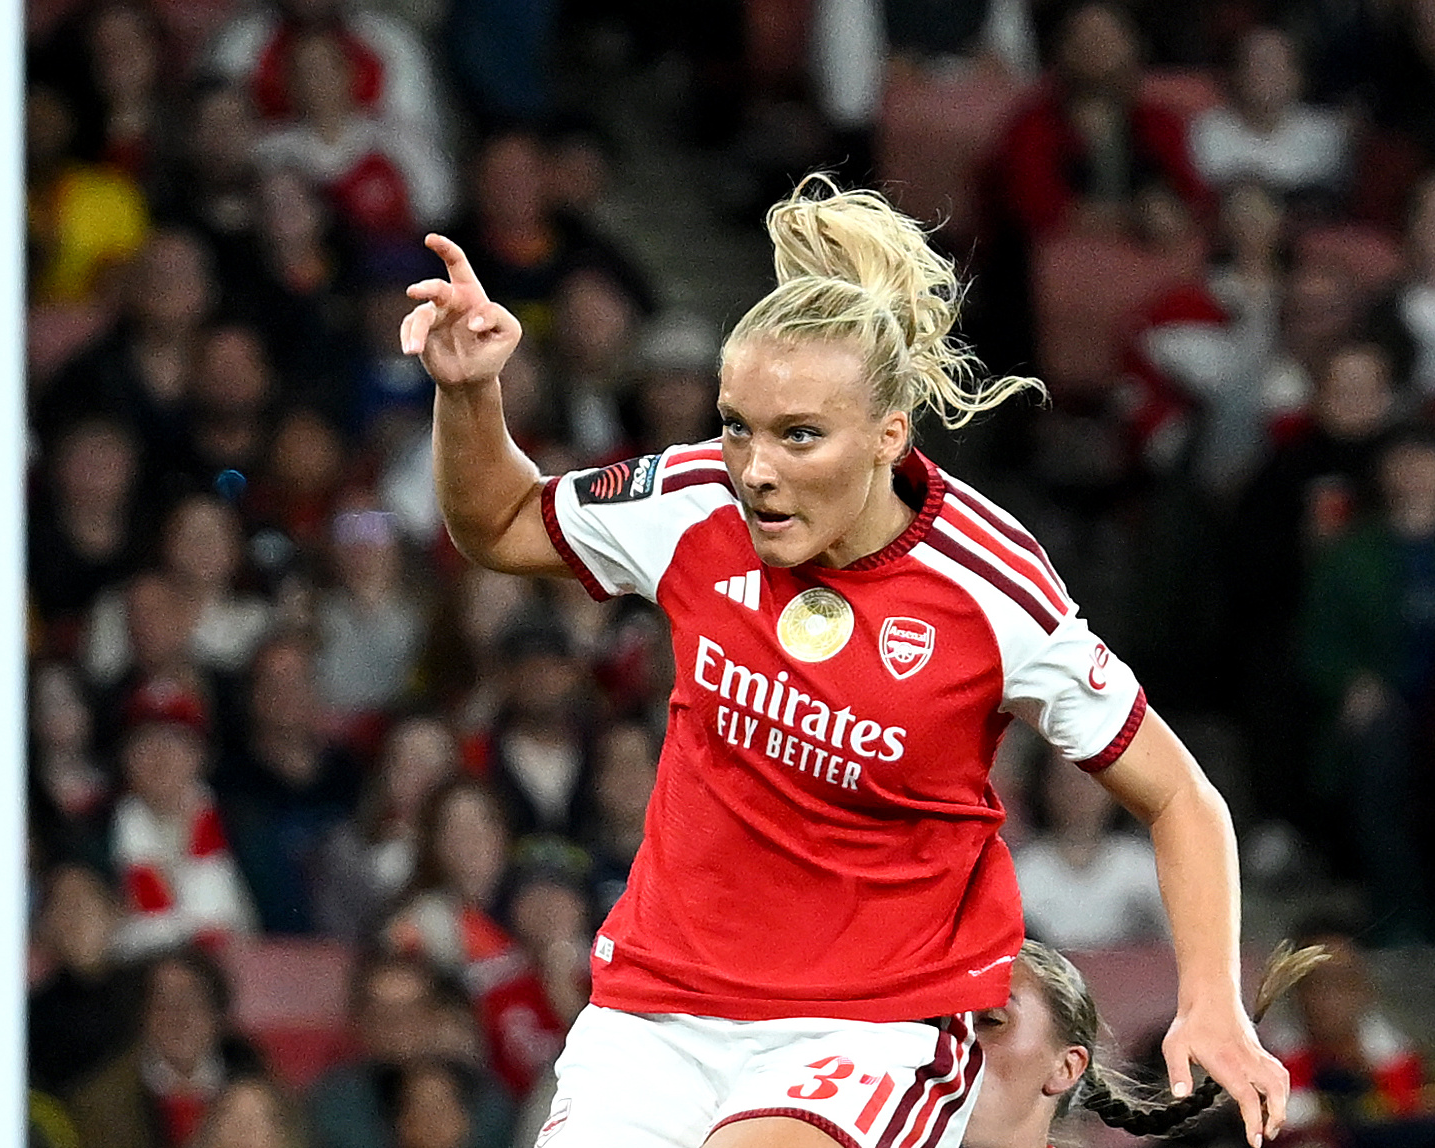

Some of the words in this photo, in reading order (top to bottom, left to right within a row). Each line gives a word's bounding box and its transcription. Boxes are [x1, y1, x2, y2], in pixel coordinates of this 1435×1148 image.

[889, 625, 927, 642] Arsenal
[694, 635, 907, 762] Emirates
[717, 704, 759, 749] FLY
[765, 727, 862, 791] BETTER
[786, 1055, 896, 1136] 31
